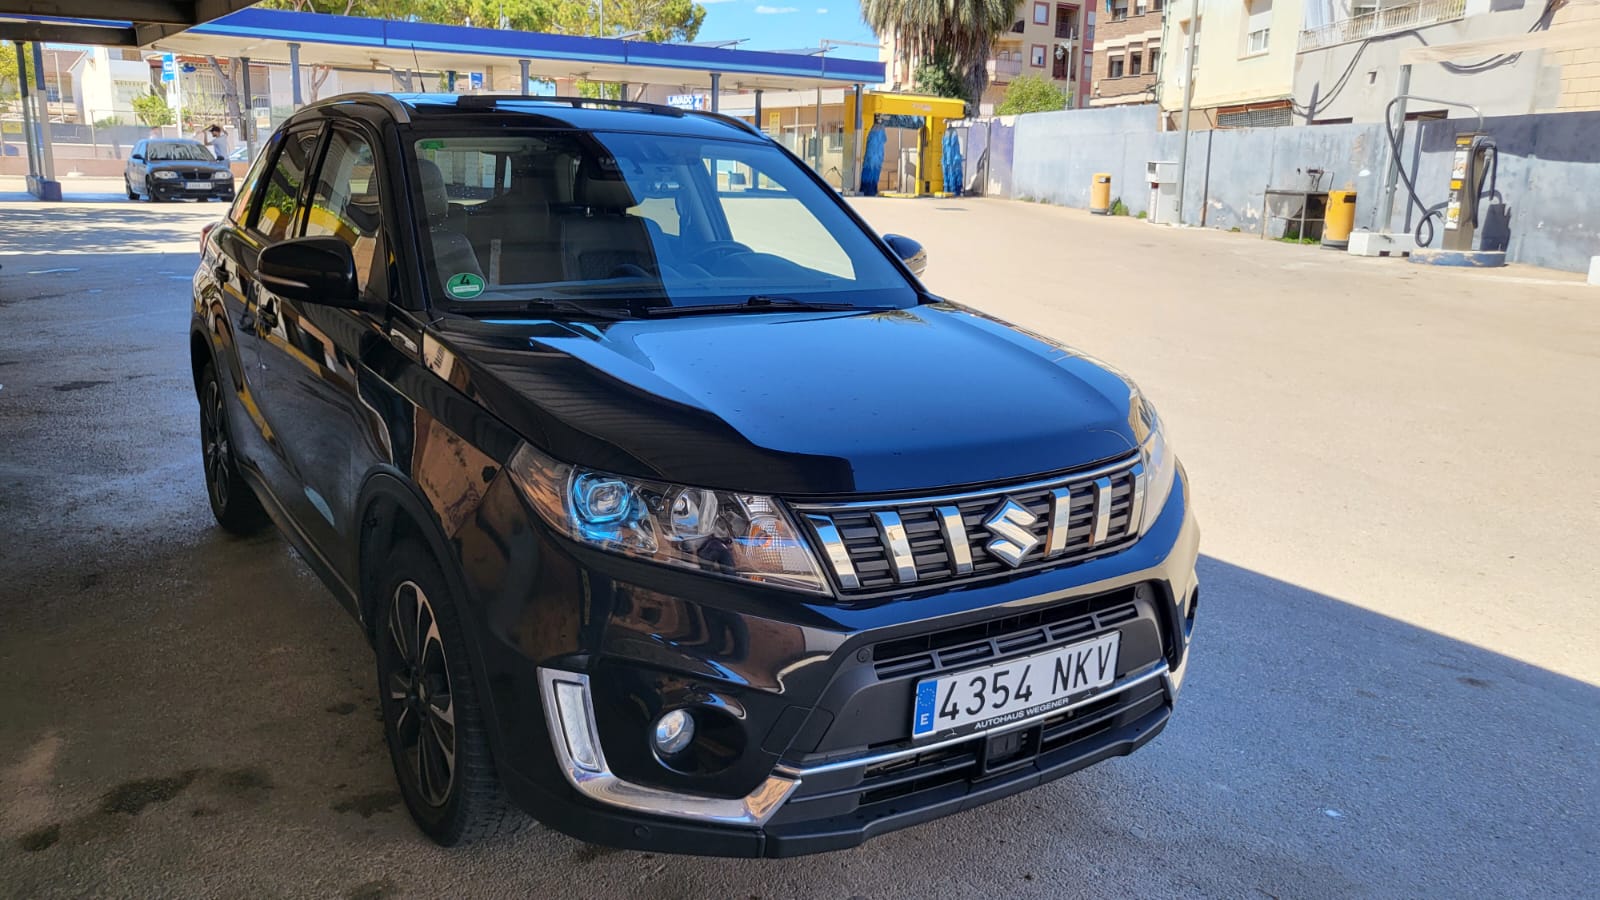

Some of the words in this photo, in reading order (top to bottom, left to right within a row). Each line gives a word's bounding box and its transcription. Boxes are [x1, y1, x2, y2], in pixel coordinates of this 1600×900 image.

[460, 274, 470, 285] 4
[919, 712, 931, 726] E
[938, 664, 1033, 721] 4354
[1051, 642, 1113, 695] NKV
[974, 710, 1025, 730] AUTOHAUS
[1025, 697, 1070, 716] WEGENER
